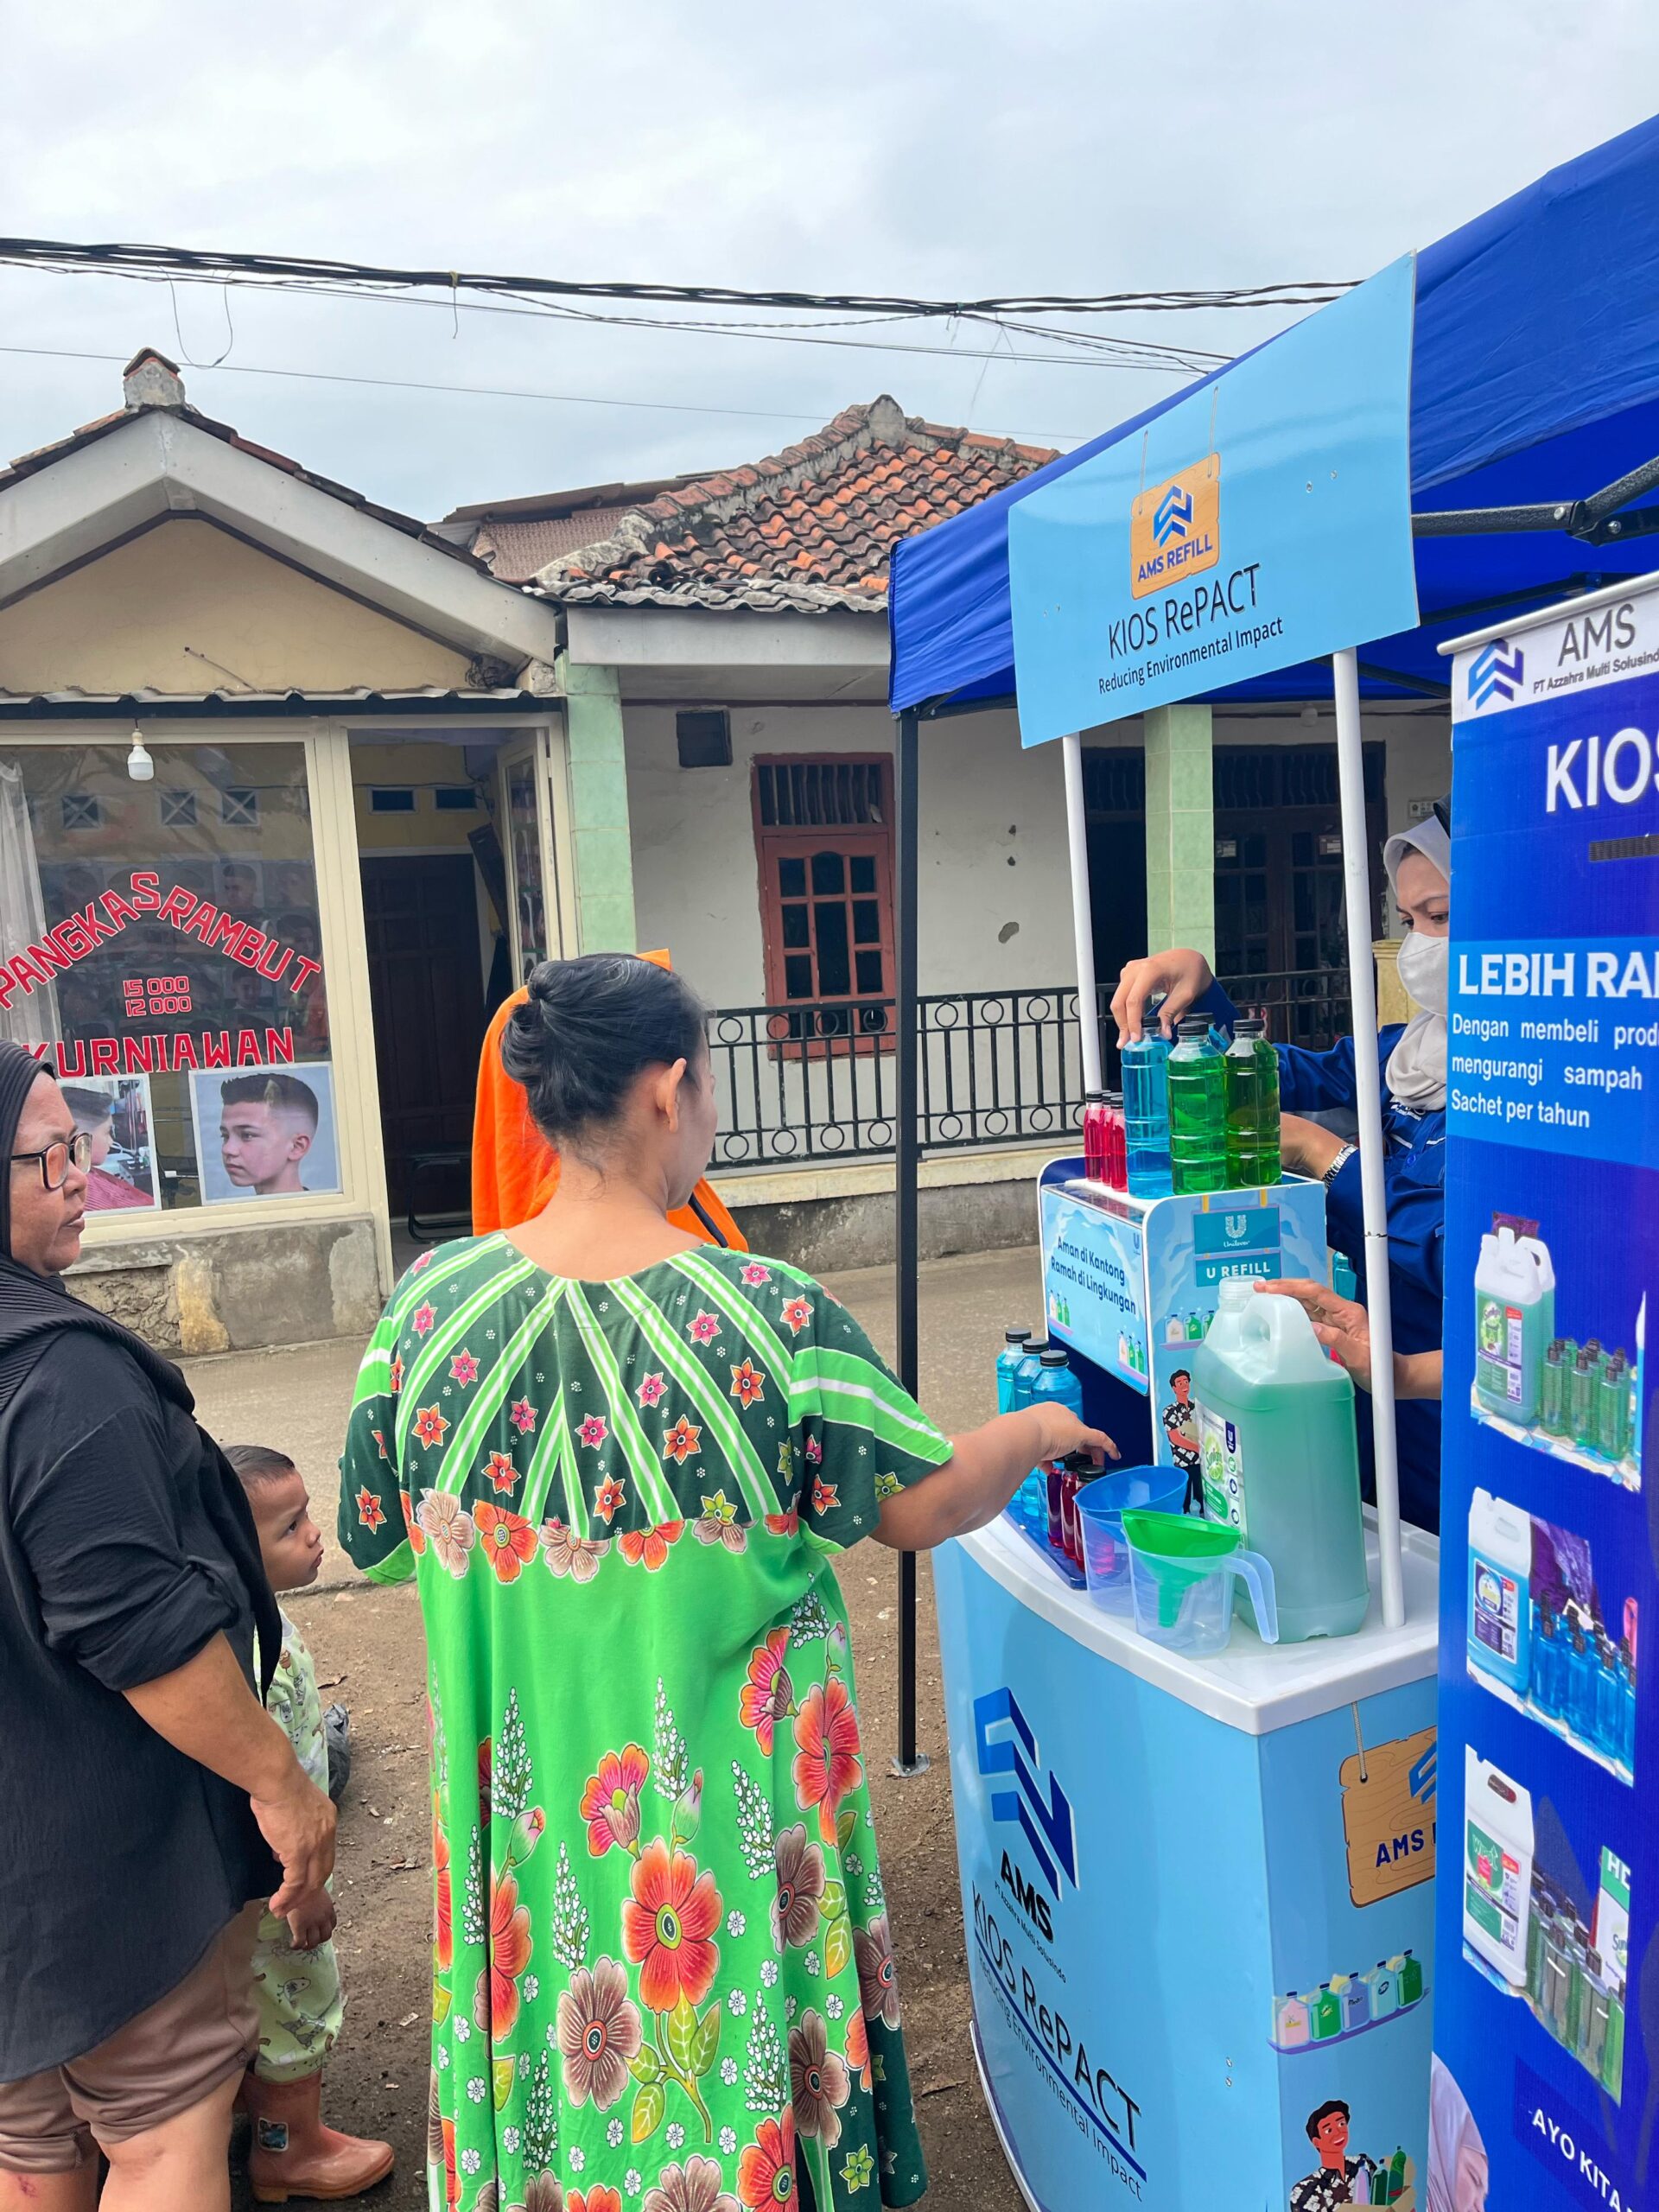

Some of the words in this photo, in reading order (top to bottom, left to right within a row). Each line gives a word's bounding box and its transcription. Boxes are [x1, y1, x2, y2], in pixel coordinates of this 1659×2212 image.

[1137, 553, 1164, 583] AMS
[1166, 534, 1213, 569] REFILL
[1108, 606, 1159, 659] KIOS
[1164, 563, 1261, 640] RePACT
[1558, 603, 1637, 666] AMS
[1098, 666, 1145, 695] Reducing
[1147, 632, 1233, 678] Environmental
[1236, 617, 1284, 652] Impact
[1533, 679, 1546, 694] PT
[1547, 671, 1585, 691] Azzahra
[1586, 661, 1611, 680] Multi
[1546, 728, 1659, 812] KIO
[0, 871, 161, 1011] PANGKAS
[157, 885, 321, 994] RAMBUT
[1459, 953, 1575, 997] LEBIH
[1586, 951, 1659, 998] RA
[1452, 1013, 1509, 1042] Dengan
[1521, 1018, 1599, 1043] membeli
[1614, 1021, 1659, 1050] prod
[1452, 1056, 1543, 1086] mengurangi
[1564, 1065, 1643, 1093] sampah
[1452, 1089, 1502, 1116] Sachet
[1506, 1101, 1534, 1122] per
[1538, 1101, 1590, 1128] tahun
[1051, 1255, 1077, 1283] Ramah
[1077, 1269, 1085, 1287] di
[1086, 1274, 1136, 1314] Lingkungan
[1058, 1236, 1079, 1260] Aman
[1080, 1247, 1088, 1263] di
[1089, 1250, 1125, 1287] Kantong
[1206, 1267, 1216, 1279] U
[1221, 1262, 1270, 1277] REFILL
[1376, 1829, 1424, 1868] AMS
[1001, 1848, 1053, 1944] AMS
[972, 1879, 1017, 1994] KIOS
[1021, 1965, 1142, 2152] RePACT
[1012, 2013, 1090, 2139] Environmental
[1093, 2126, 1143, 2202] Impact
[1532, 2108, 1575, 2160] AYO
[1580, 2150, 1622, 2212] KITA
